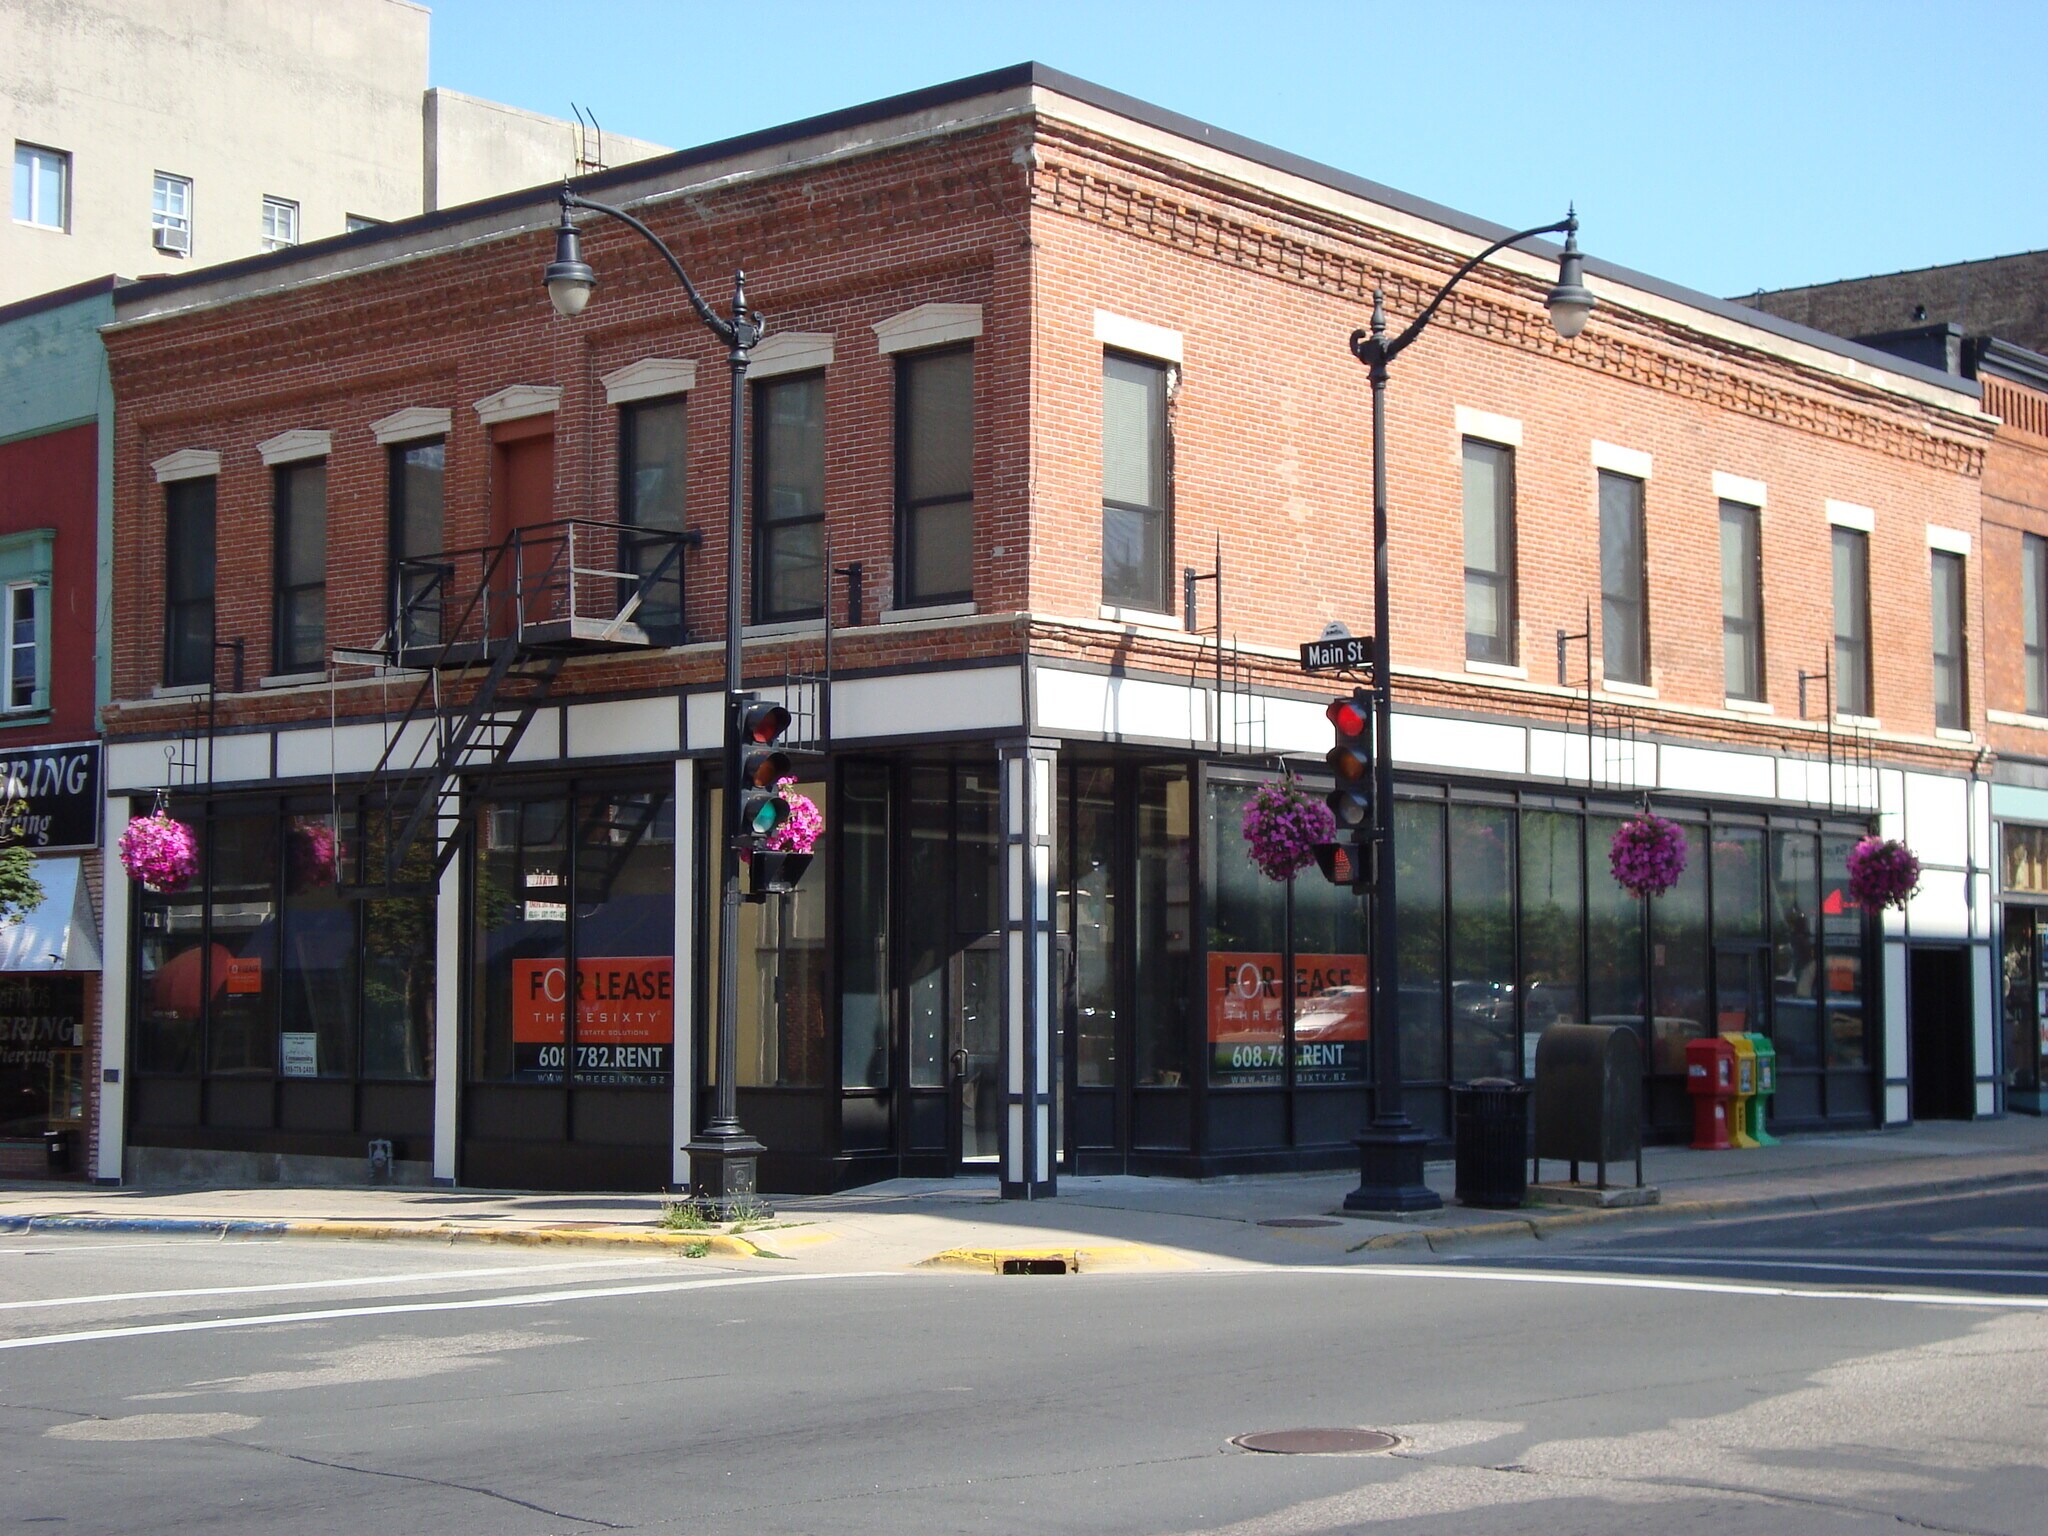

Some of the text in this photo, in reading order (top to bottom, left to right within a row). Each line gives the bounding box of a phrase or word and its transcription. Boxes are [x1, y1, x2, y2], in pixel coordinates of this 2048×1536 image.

[1308, 641, 1364, 666] Main St
[595, 970, 672, 1001] LEASE
[1225, 962, 1351, 999] FOR EASE
[538, 1046, 663, 1068] 60782.RENT
[1232, 1044, 1345, 1068] 608.78.RENT
